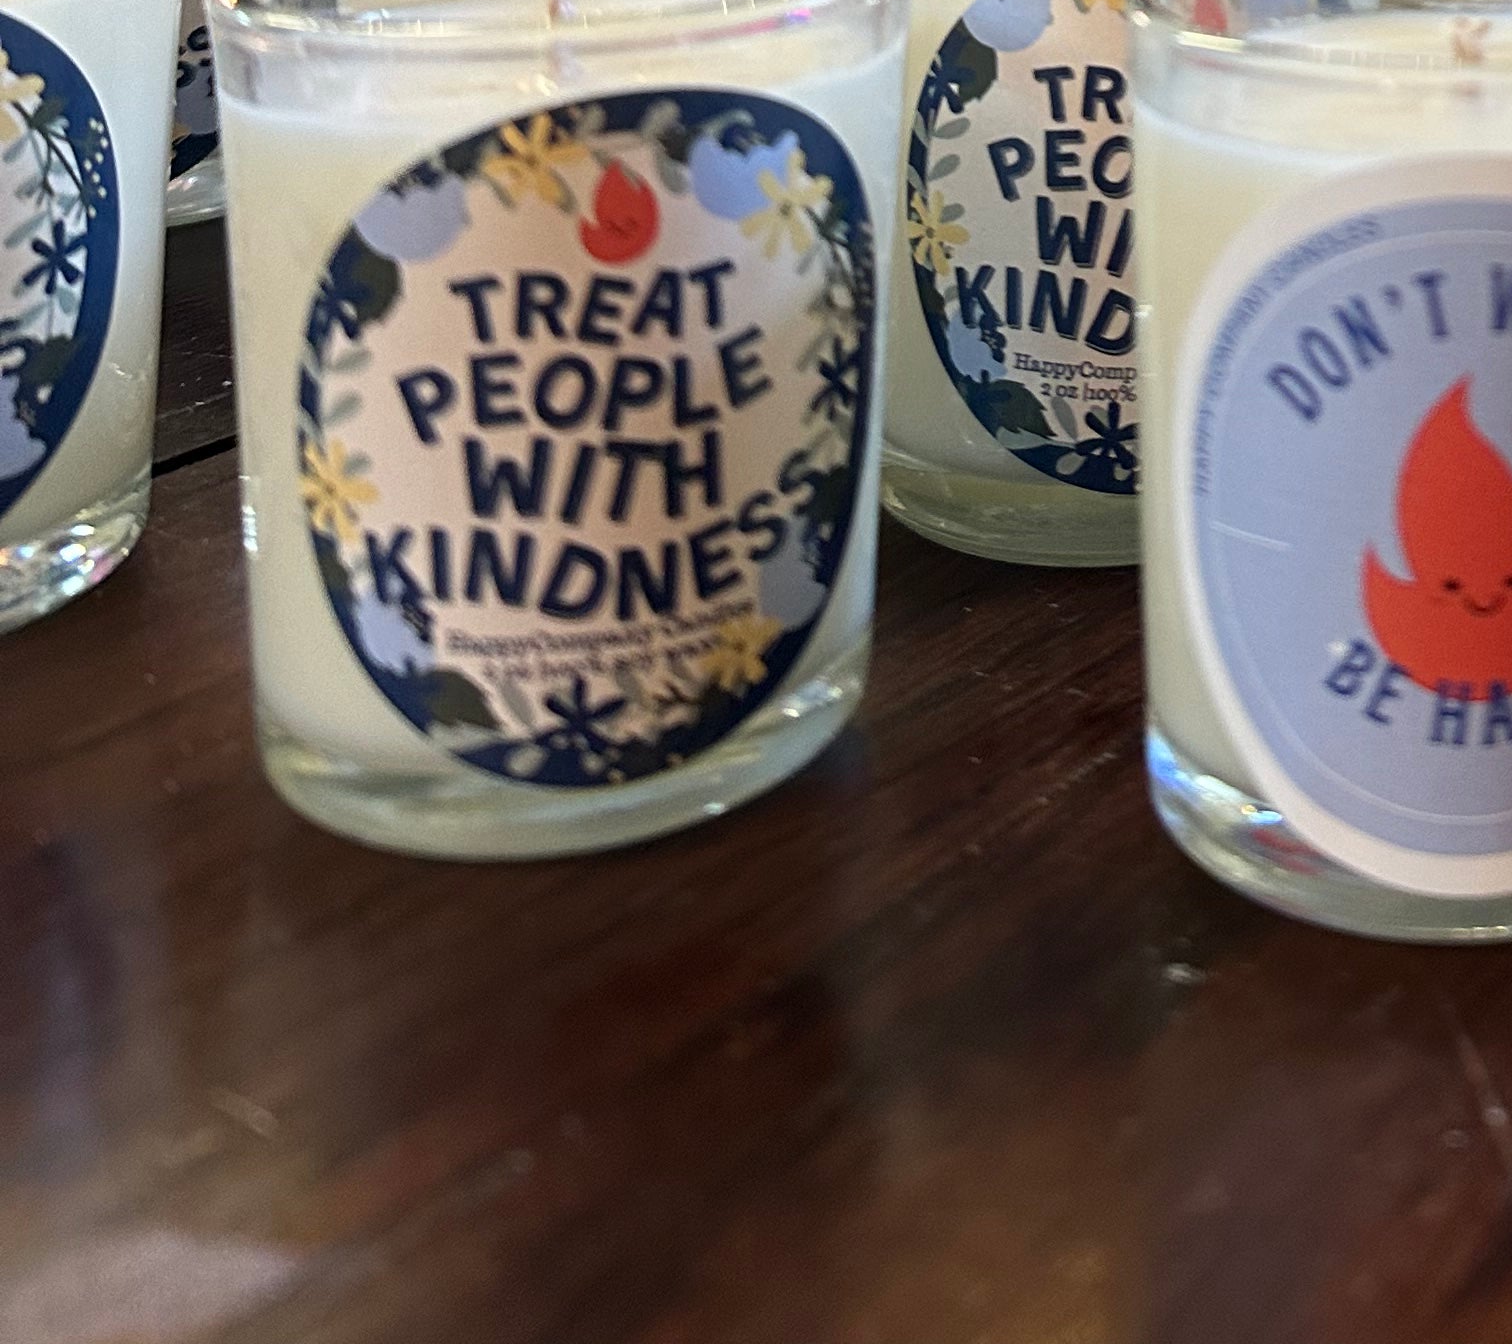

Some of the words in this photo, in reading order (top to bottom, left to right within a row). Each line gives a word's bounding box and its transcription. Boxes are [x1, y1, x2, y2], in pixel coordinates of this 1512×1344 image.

[448, 258, 736, 346] TREAT
[955, 263, 1136, 357] KIND
[1263, 270, 1451, 423] DON'T
[395, 324, 774, 444] PEOPLE
[1013, 351, 1138, 384] HappyComp
[463, 429, 726, 526] WITH
[361, 449, 818, 622] KINDNESS
[1325, 638, 1410, 726] BE
